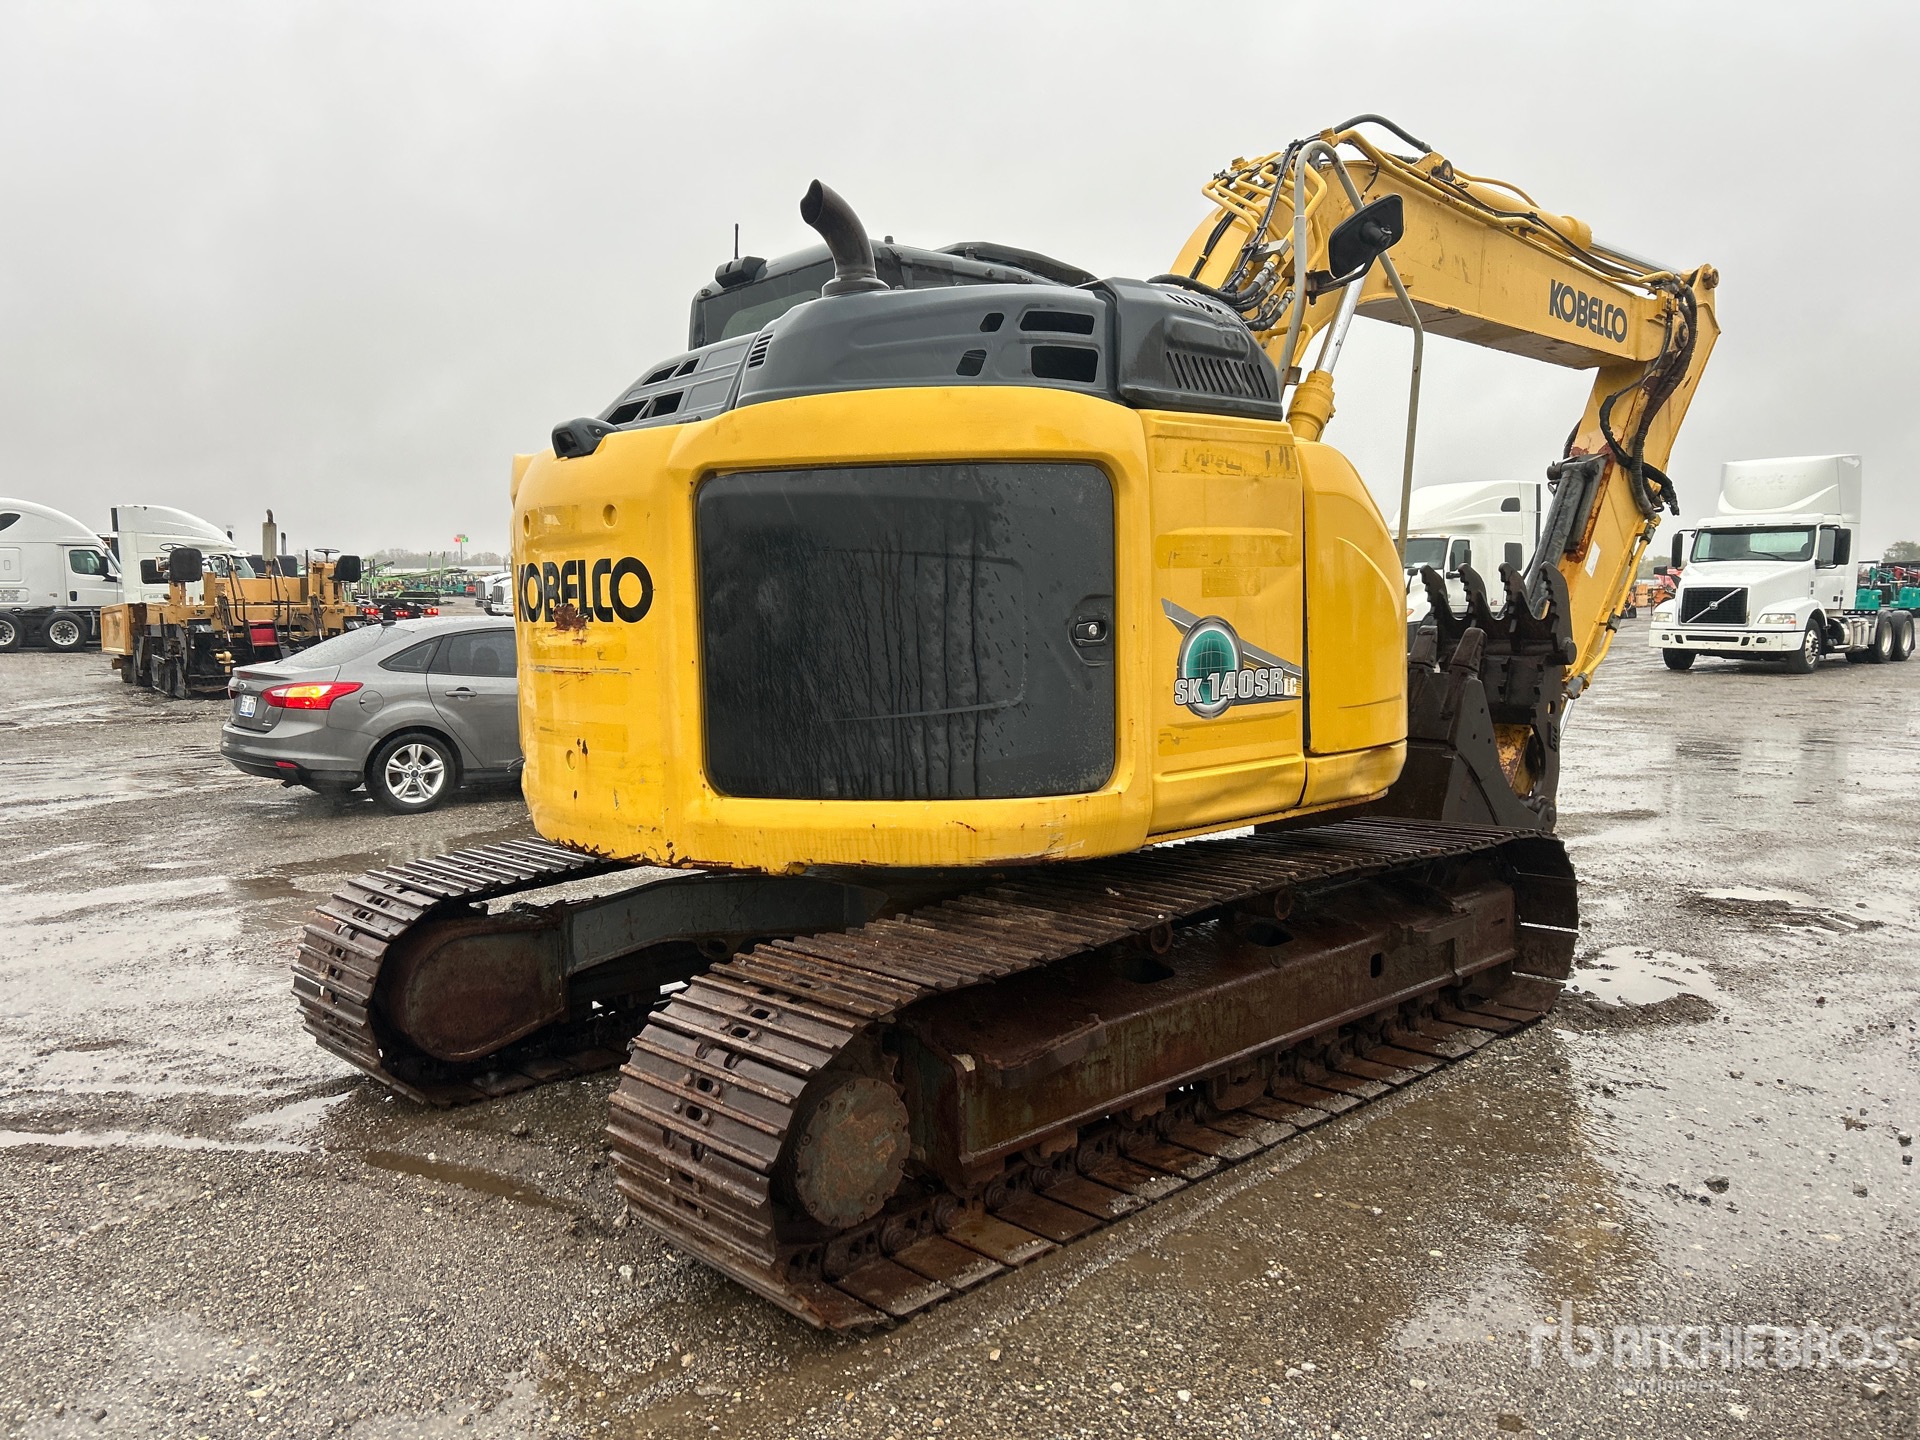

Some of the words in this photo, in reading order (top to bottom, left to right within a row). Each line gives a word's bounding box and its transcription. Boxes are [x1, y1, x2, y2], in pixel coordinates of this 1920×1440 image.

[1549, 279, 1628, 344] KOBELCO
[516, 556, 654, 624] KOBELCO
[1174, 677, 1204, 705] SK
